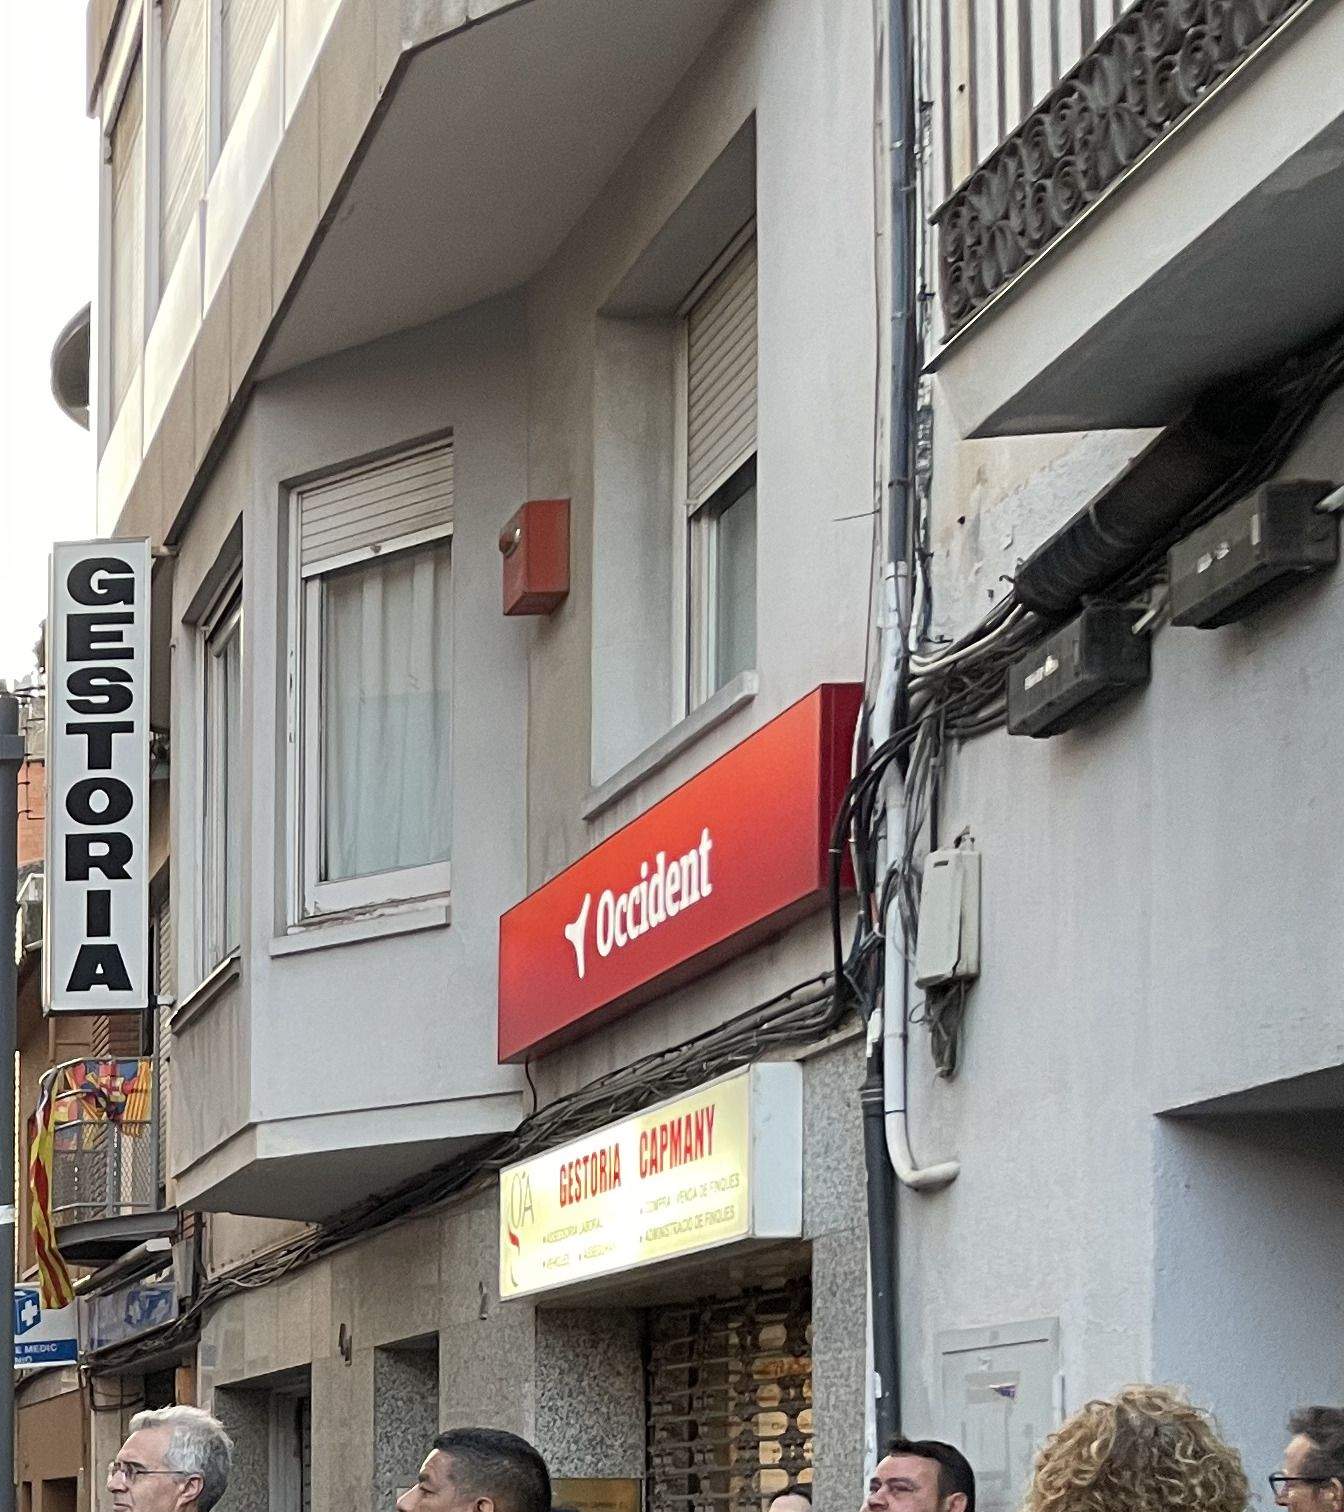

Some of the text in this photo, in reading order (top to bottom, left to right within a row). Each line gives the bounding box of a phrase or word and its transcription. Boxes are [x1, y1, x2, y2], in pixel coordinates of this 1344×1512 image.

[65, 557, 135, 992] GESTORIA
[596, 827, 712, 957] Occident
[560, 1103, 716, 1208] GESTORIA CAPMANY
